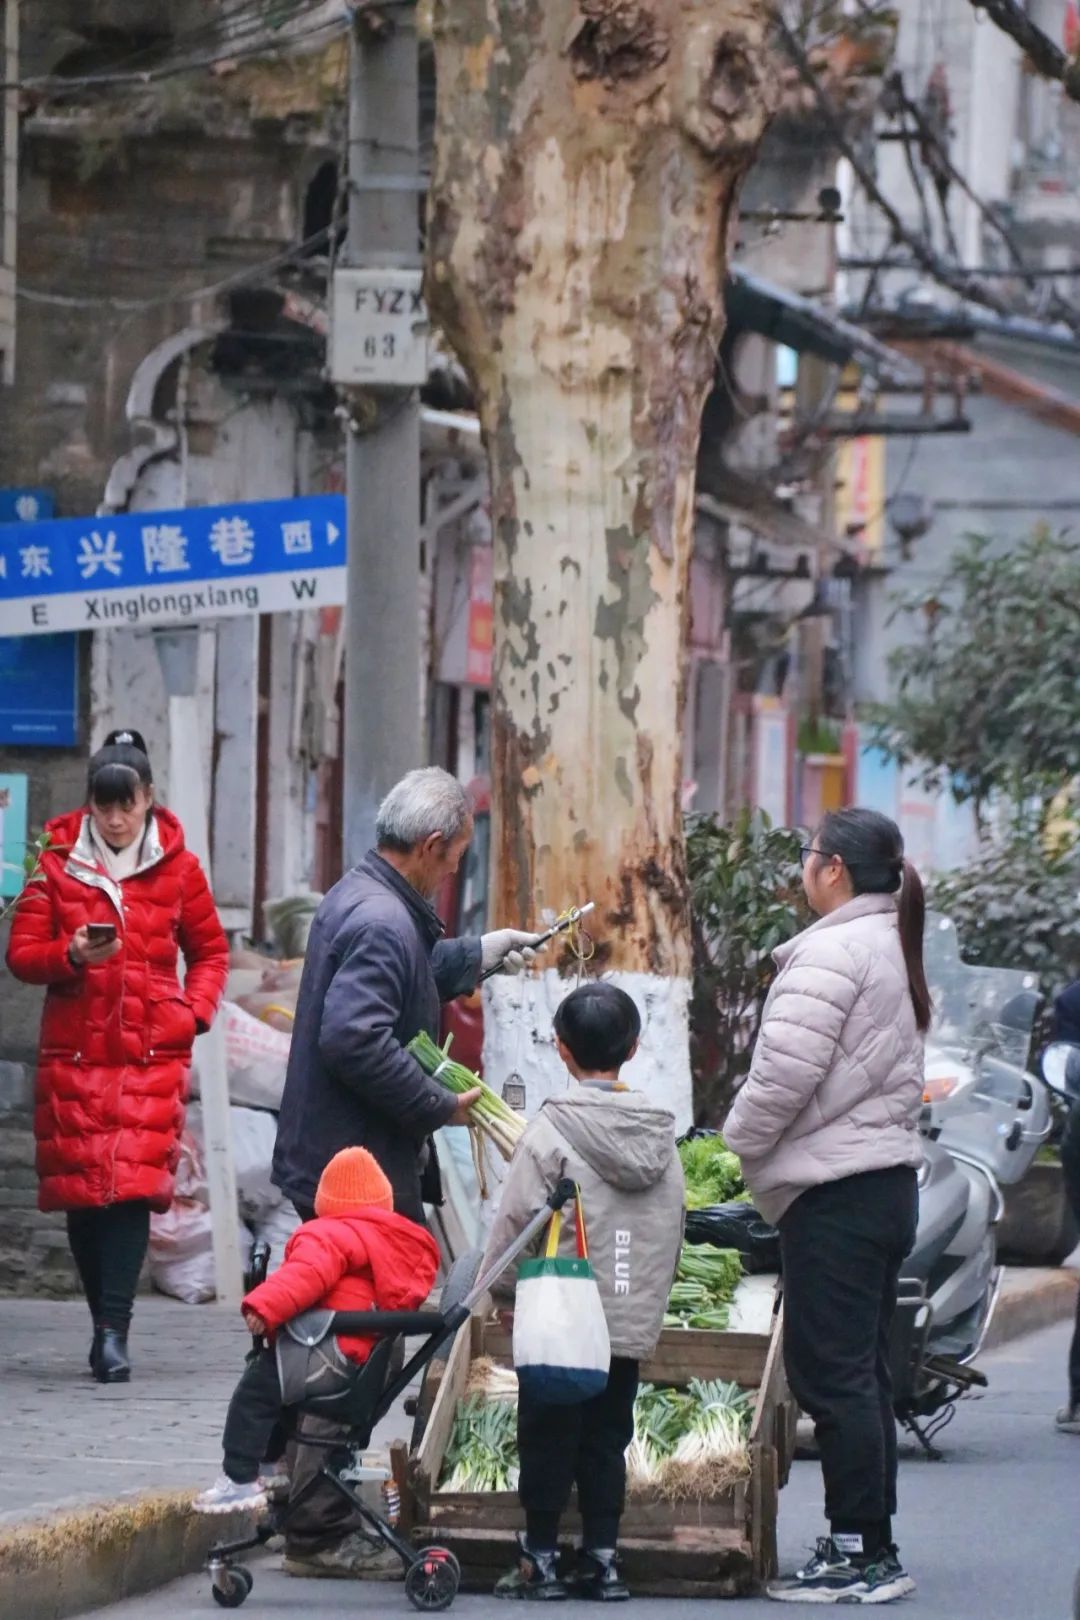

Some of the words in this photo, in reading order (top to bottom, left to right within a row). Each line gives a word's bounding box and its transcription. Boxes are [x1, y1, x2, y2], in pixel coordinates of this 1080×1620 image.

[364, 333, 395, 358] 63
[19, 544, 53, 578] 东
[76, 515, 255, 579] 兴隆巷
[280, 519, 313, 556] 西
[31, 603, 48, 626] E
[85, 585, 259, 622] Xinglongxiang
[291, 577, 317, 600] W
[615, 1230, 631, 1297] BLUE
